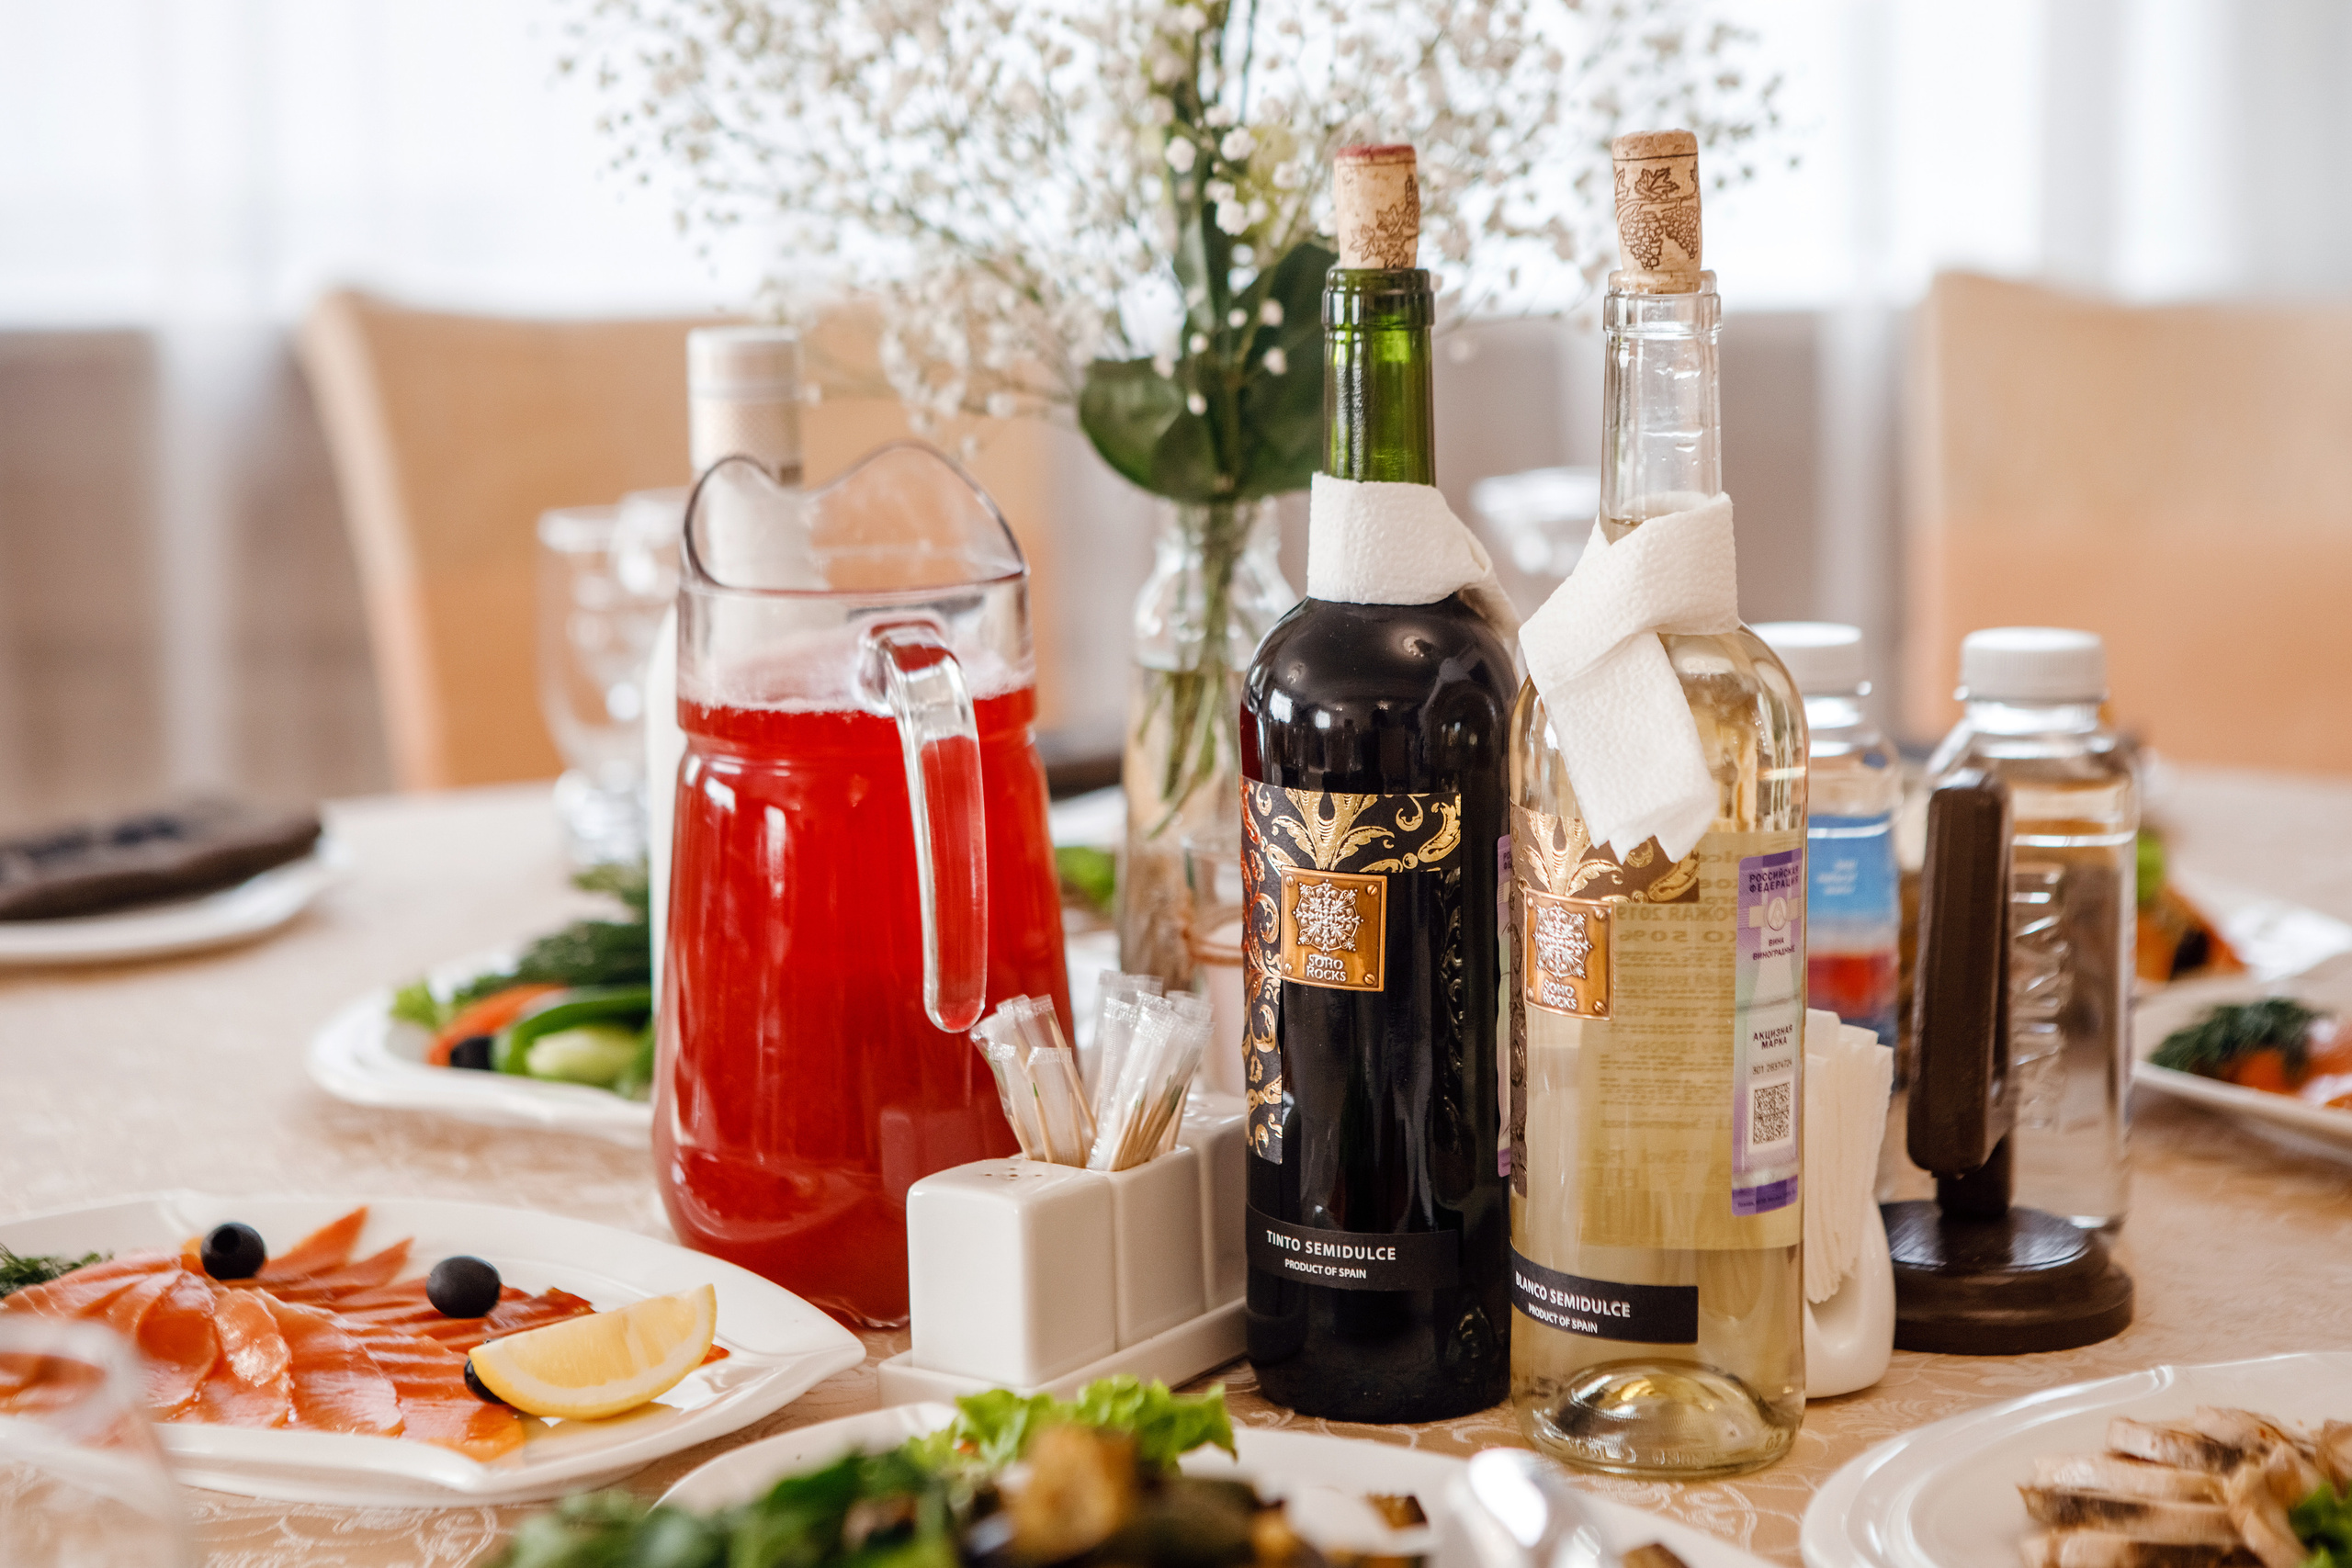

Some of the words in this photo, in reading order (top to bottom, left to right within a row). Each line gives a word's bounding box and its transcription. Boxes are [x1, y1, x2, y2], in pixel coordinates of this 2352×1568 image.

[1749, 865, 1799, 883] РОССИЙСКАЯ
[1749, 875, 1799, 894] ФЕДЕРАЦИЯ
[1769, 937, 1784, 946] ВИНА
[1308, 953, 1343, 970] SOHO
[1752, 944, 1795, 961] ВИНОГРАДНЫЕ
[1306, 964, 1346, 982] ROCKS
[1544, 978, 1575, 998] SOHO
[1543, 988, 1577, 1010] ROCKS
[1753, 1024, 1792, 1042] АКЦИЗНАЯ
[1761, 1036, 1787, 1050] МАРКА
[1266, 1229, 1301, 1252] TINTO
[1305, 1240, 1396, 1261] SEMIDULCE
[1284, 1258, 1323, 1275] PRODUCT
[1324, 1266, 1338, 1277] OF
[1339, 1268, 1367, 1280] SPAIN
[1515, 1269, 1547, 1301] BLANCO
[1549, 1288, 1631, 1319] SEMIDULCE
[1528, 1302, 1558, 1325] PRODUCT
[1558, 1314, 1570, 1328] OF
[1571, 1317, 1598, 1335] SPAIN
